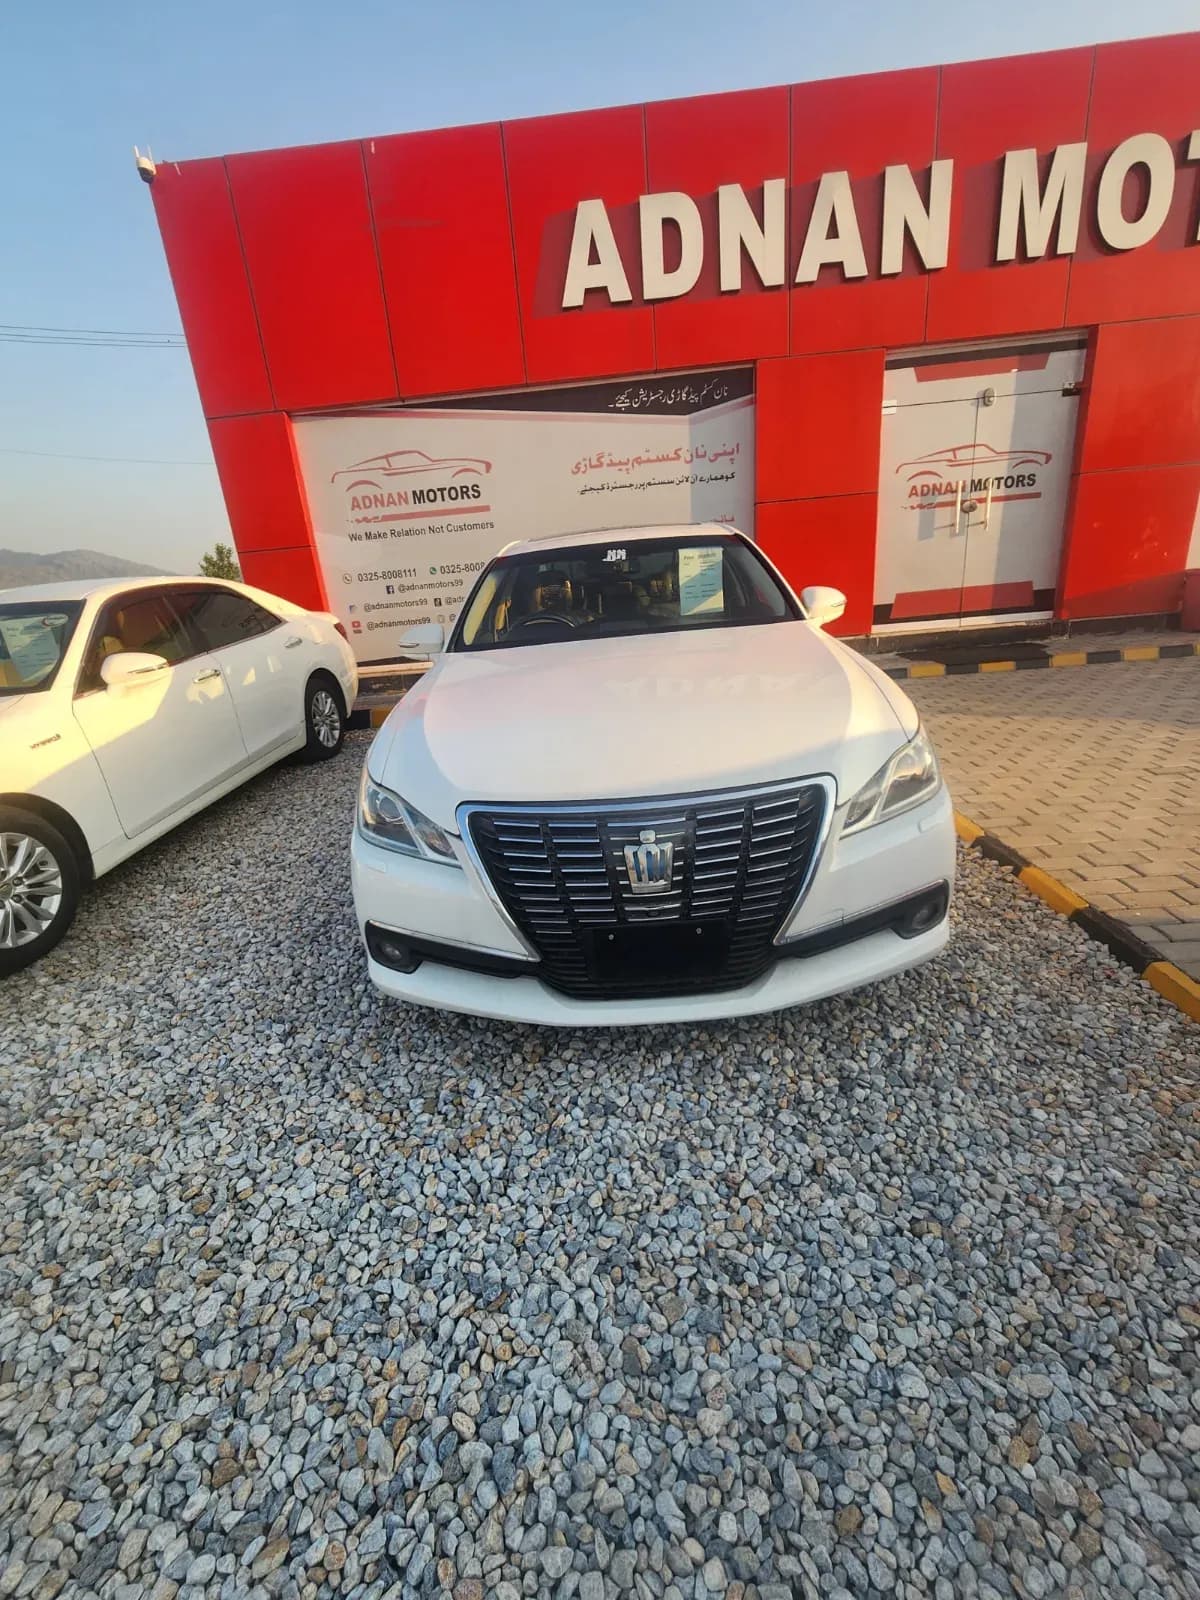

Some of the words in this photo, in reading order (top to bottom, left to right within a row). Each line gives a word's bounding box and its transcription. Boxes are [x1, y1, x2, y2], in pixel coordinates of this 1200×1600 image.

[562, 159, 954, 308] ADNAN
[996, 131, 1200, 262] MO
[632, 388, 668, 407] رجسٹریشن
[667, 385, 690, 404] گاڑی
[700, 378, 720, 405] کسٹم
[714, 384, 728, 399] نان
[571, 452, 604, 475] گاڑی
[631, 447, 683, 470] کسٹم
[684, 445, 707, 464] نان
[708, 442, 740, 465] اپنی
[908, 480, 967, 498] ADNAN
[970, 473, 1037, 493] MOTORS
[351, 491, 410, 512] ADNAN
[412, 483, 481, 505] MOTORS
[348, 532, 363, 542] We
[364, 530, 388, 542] Make
[390, 526, 427, 539] Relation
[428, 525, 445, 535] Not
[446, 521, 495, 533] Customers
[357, 568, 417, 583] 0325-8008111
[398, 579, 464, 593] @adnanmotors99
[364, 598, 428, 612] @adnanmotors99
[367, 617, 431, 631] @adnanmotors99
